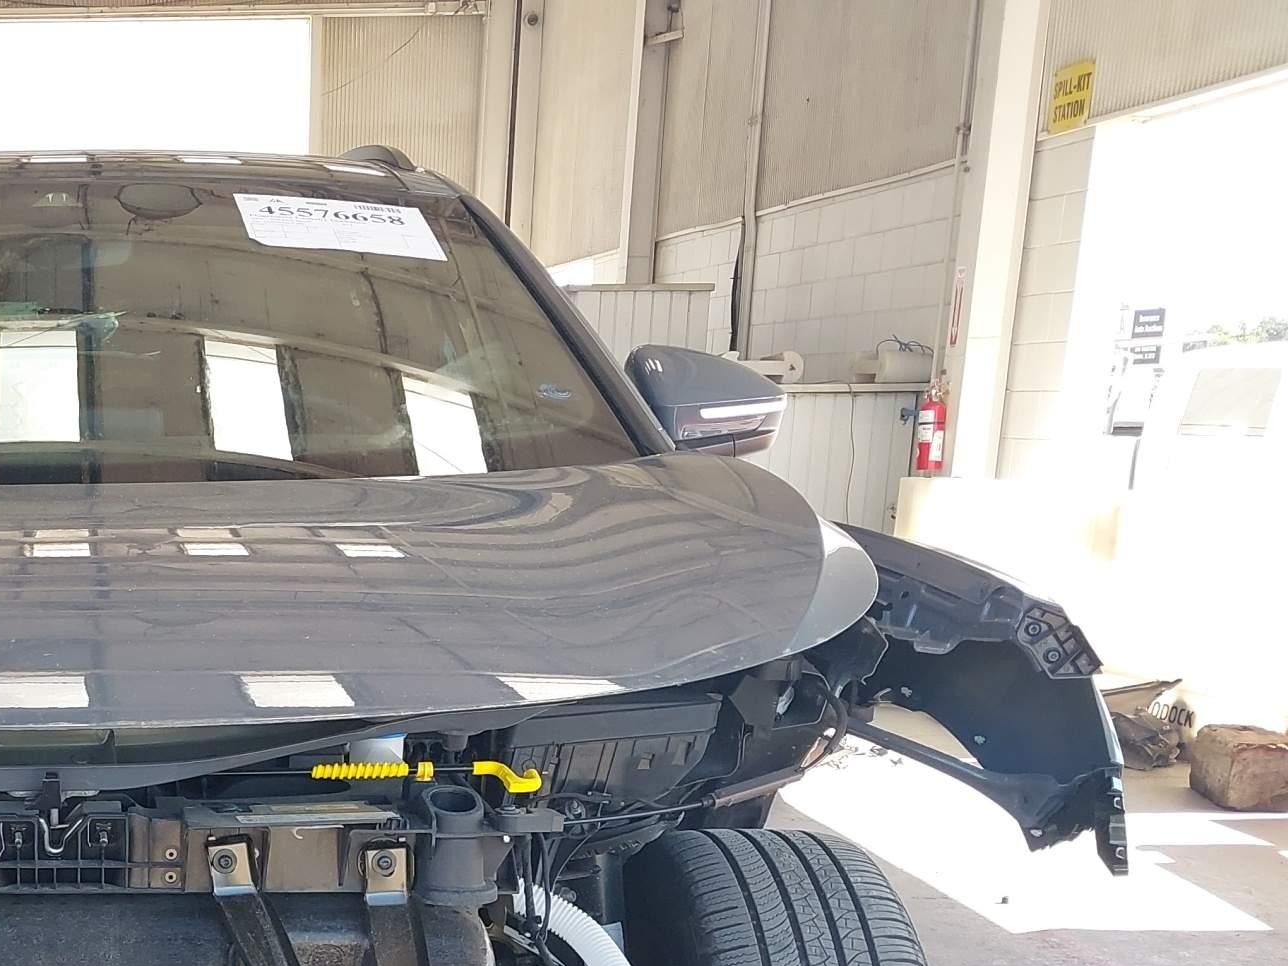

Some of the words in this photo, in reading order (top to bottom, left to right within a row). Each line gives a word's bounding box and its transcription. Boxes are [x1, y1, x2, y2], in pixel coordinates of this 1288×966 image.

[1054, 72, 1092, 100] SPILL-KIT
[1053, 98, 1086, 123] STATION
[259, 205, 406, 226] 45576658
